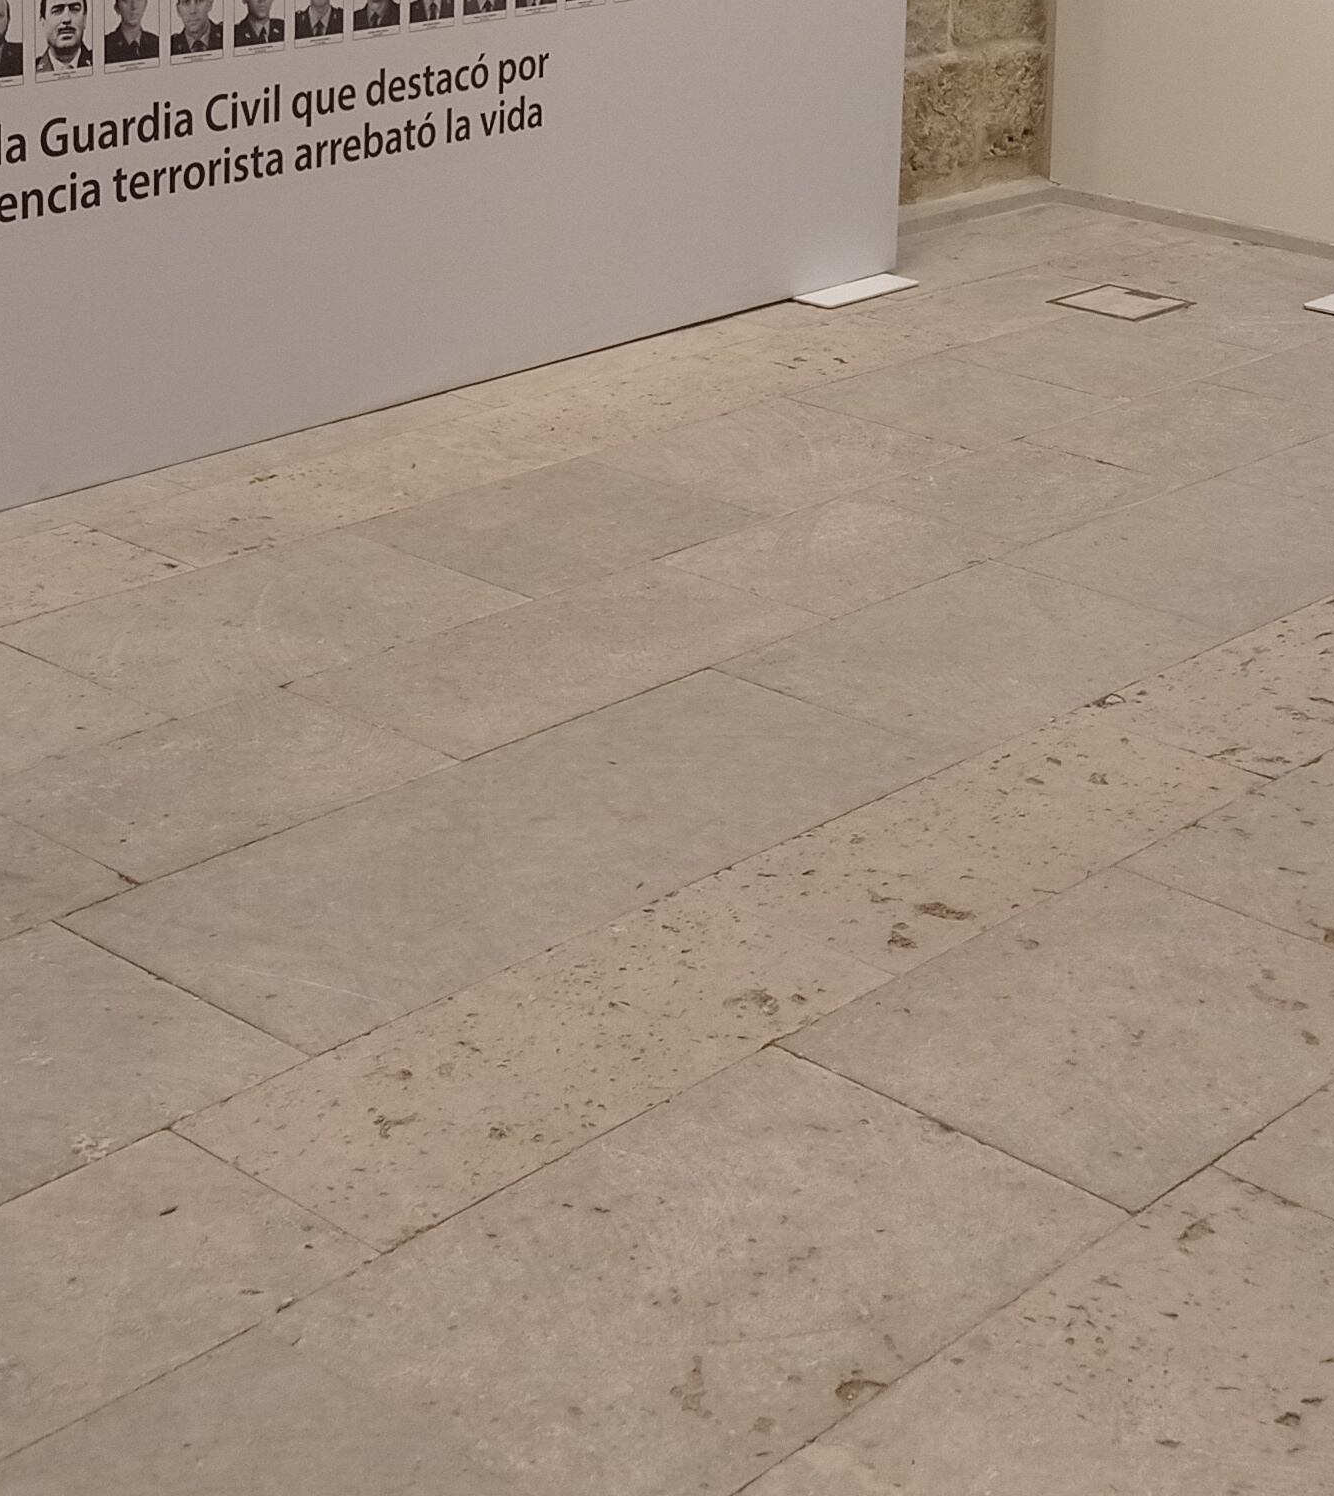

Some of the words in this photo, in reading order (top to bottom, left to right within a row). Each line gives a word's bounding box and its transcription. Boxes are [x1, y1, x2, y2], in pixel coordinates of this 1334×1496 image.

[39, 100, 193, 158] Guardia
[205, 82, 281, 132] Civil
[291, 83, 357, 128] que
[365, 62, 489, 107] destacó
[498, 51, 550, 95] por
[112, 144, 284, 203] terrorista
[294, 118, 436, 172] arrebató
[445, 109, 471, 144] la
[479, 98, 543, 137] vida
